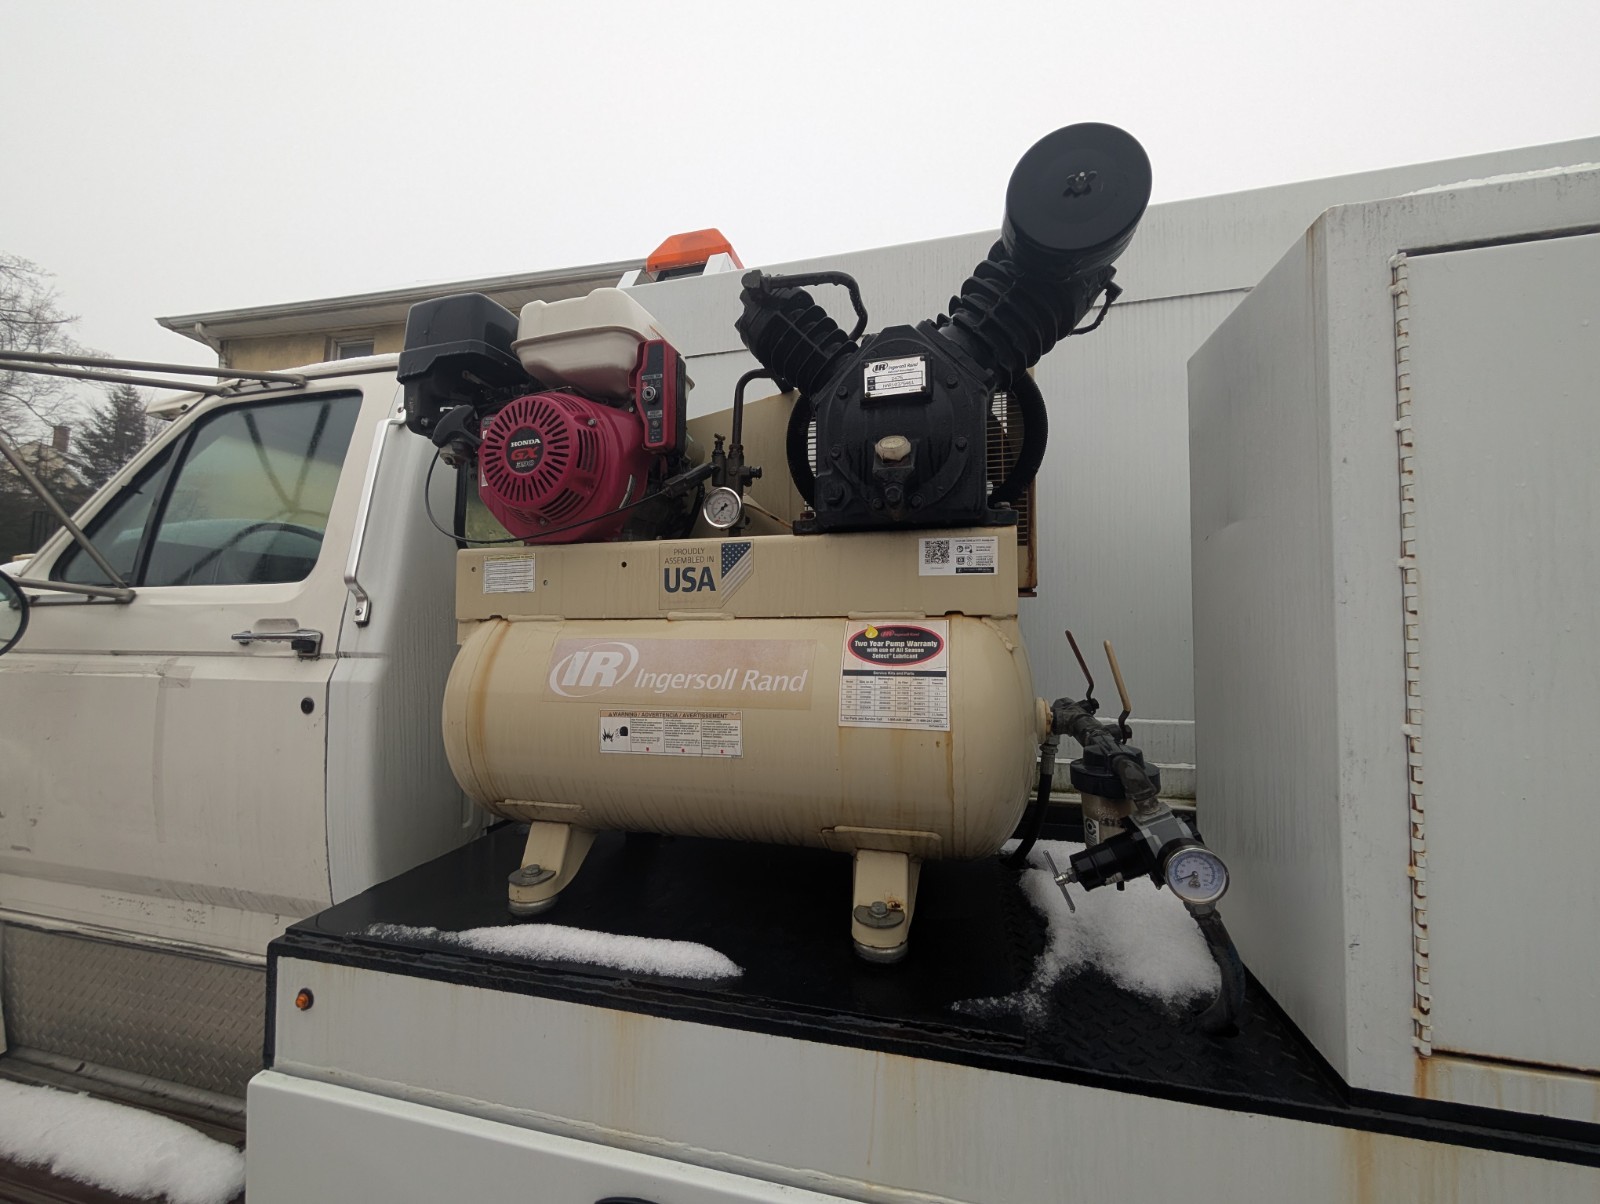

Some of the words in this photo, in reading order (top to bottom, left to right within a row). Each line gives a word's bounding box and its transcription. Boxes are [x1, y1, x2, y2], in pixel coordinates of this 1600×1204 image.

[510, 438, 541, 448] HONDA
[511, 446, 539, 461] GX
[673, 547, 705, 556] PROUDLY
[664, 556, 705, 565] ASSEMBLED
[706, 555, 715, 563] IN
[663, 566, 717, 593] USA
[885, 640, 905, 648] Pump
[906, 640, 938, 648] Warranty
[634, 667, 739, 694] Ingersoll
[741, 668, 809, 693] Rand
